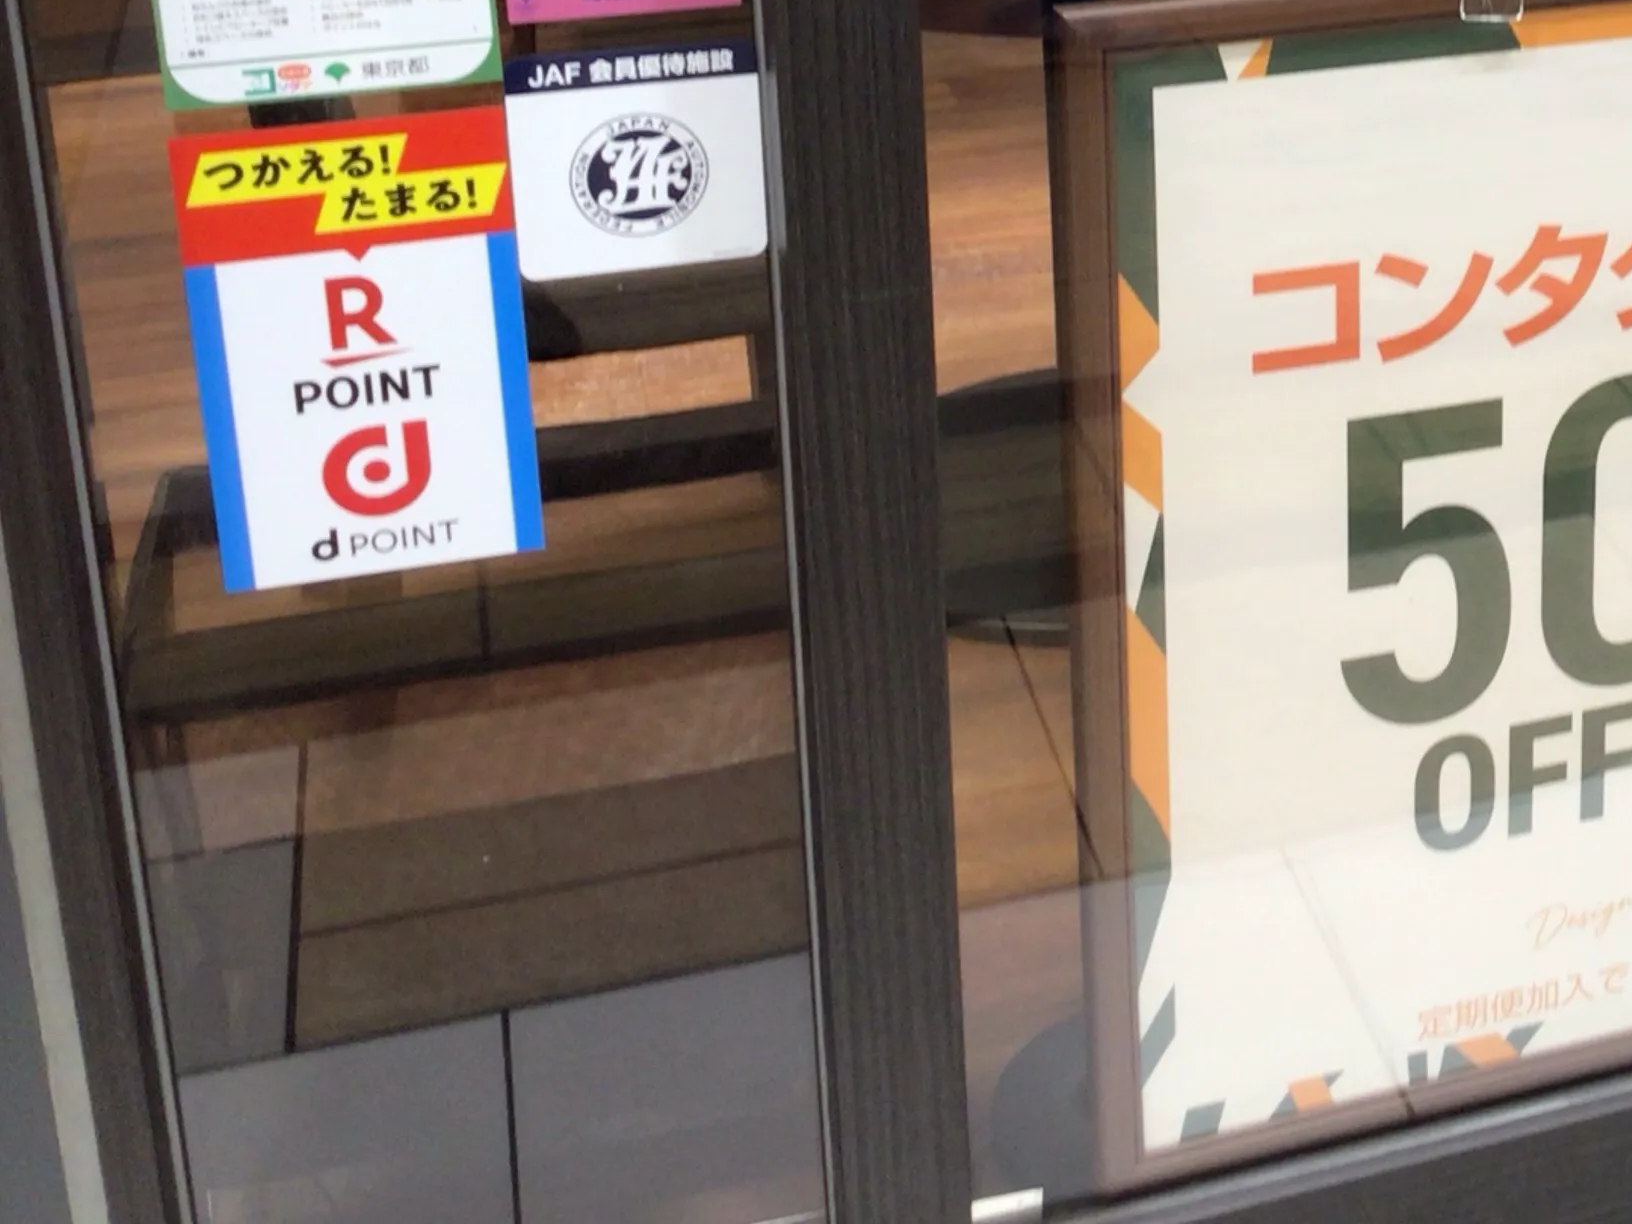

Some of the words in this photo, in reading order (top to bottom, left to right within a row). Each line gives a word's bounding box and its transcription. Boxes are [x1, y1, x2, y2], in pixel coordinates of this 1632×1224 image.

[362, 55, 430, 78] 東京都
[528, 62, 581, 89] JAF
[590, 48, 734, 85] 会員優待施設
[607, 116, 670, 135] JAPAN
[203, 144, 392, 191] つかえる!
[340, 178, 478, 222] たまる!
[323, 275, 398, 351] R
[293, 362, 441, 415] POINT
[1416, 963, 1630, 1041] 定期便加入で
